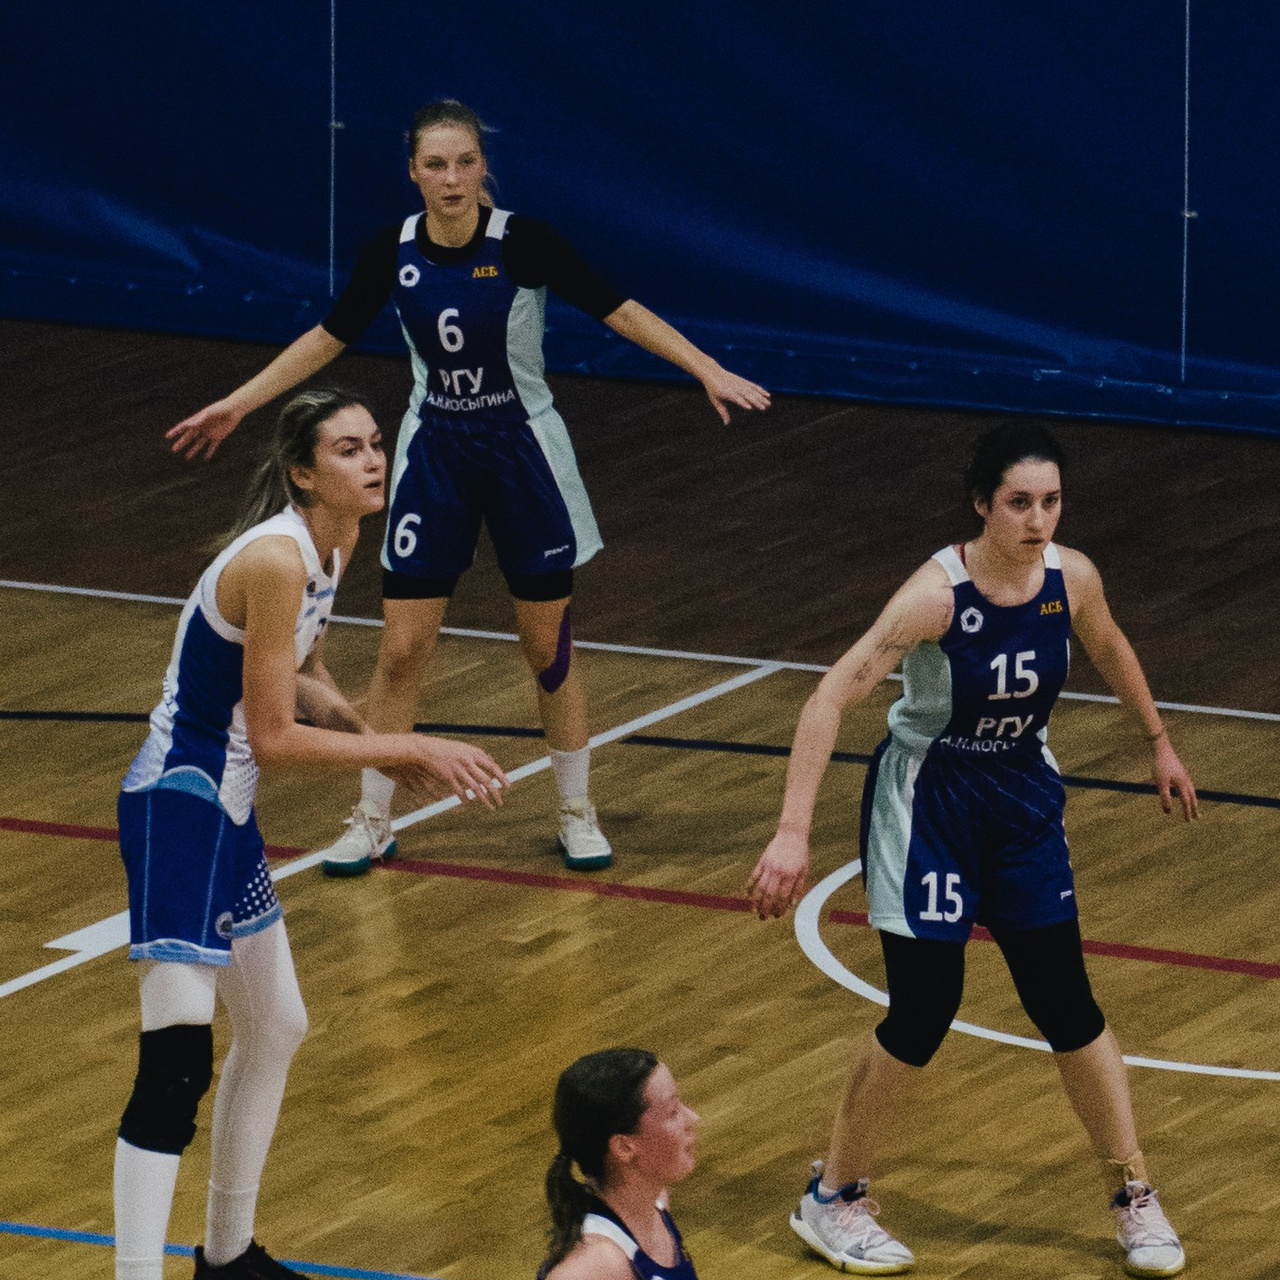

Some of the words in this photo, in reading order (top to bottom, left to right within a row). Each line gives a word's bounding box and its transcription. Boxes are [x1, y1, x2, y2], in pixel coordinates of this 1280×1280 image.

[438, 308, 464, 353] 6
[439, 367, 483, 396] РГУ
[394, 513, 421, 558] 6
[987, 650, 1039, 701] 15
[975, 714, 1034, 738] РГУ
[919, 871, 963, 923] 15
